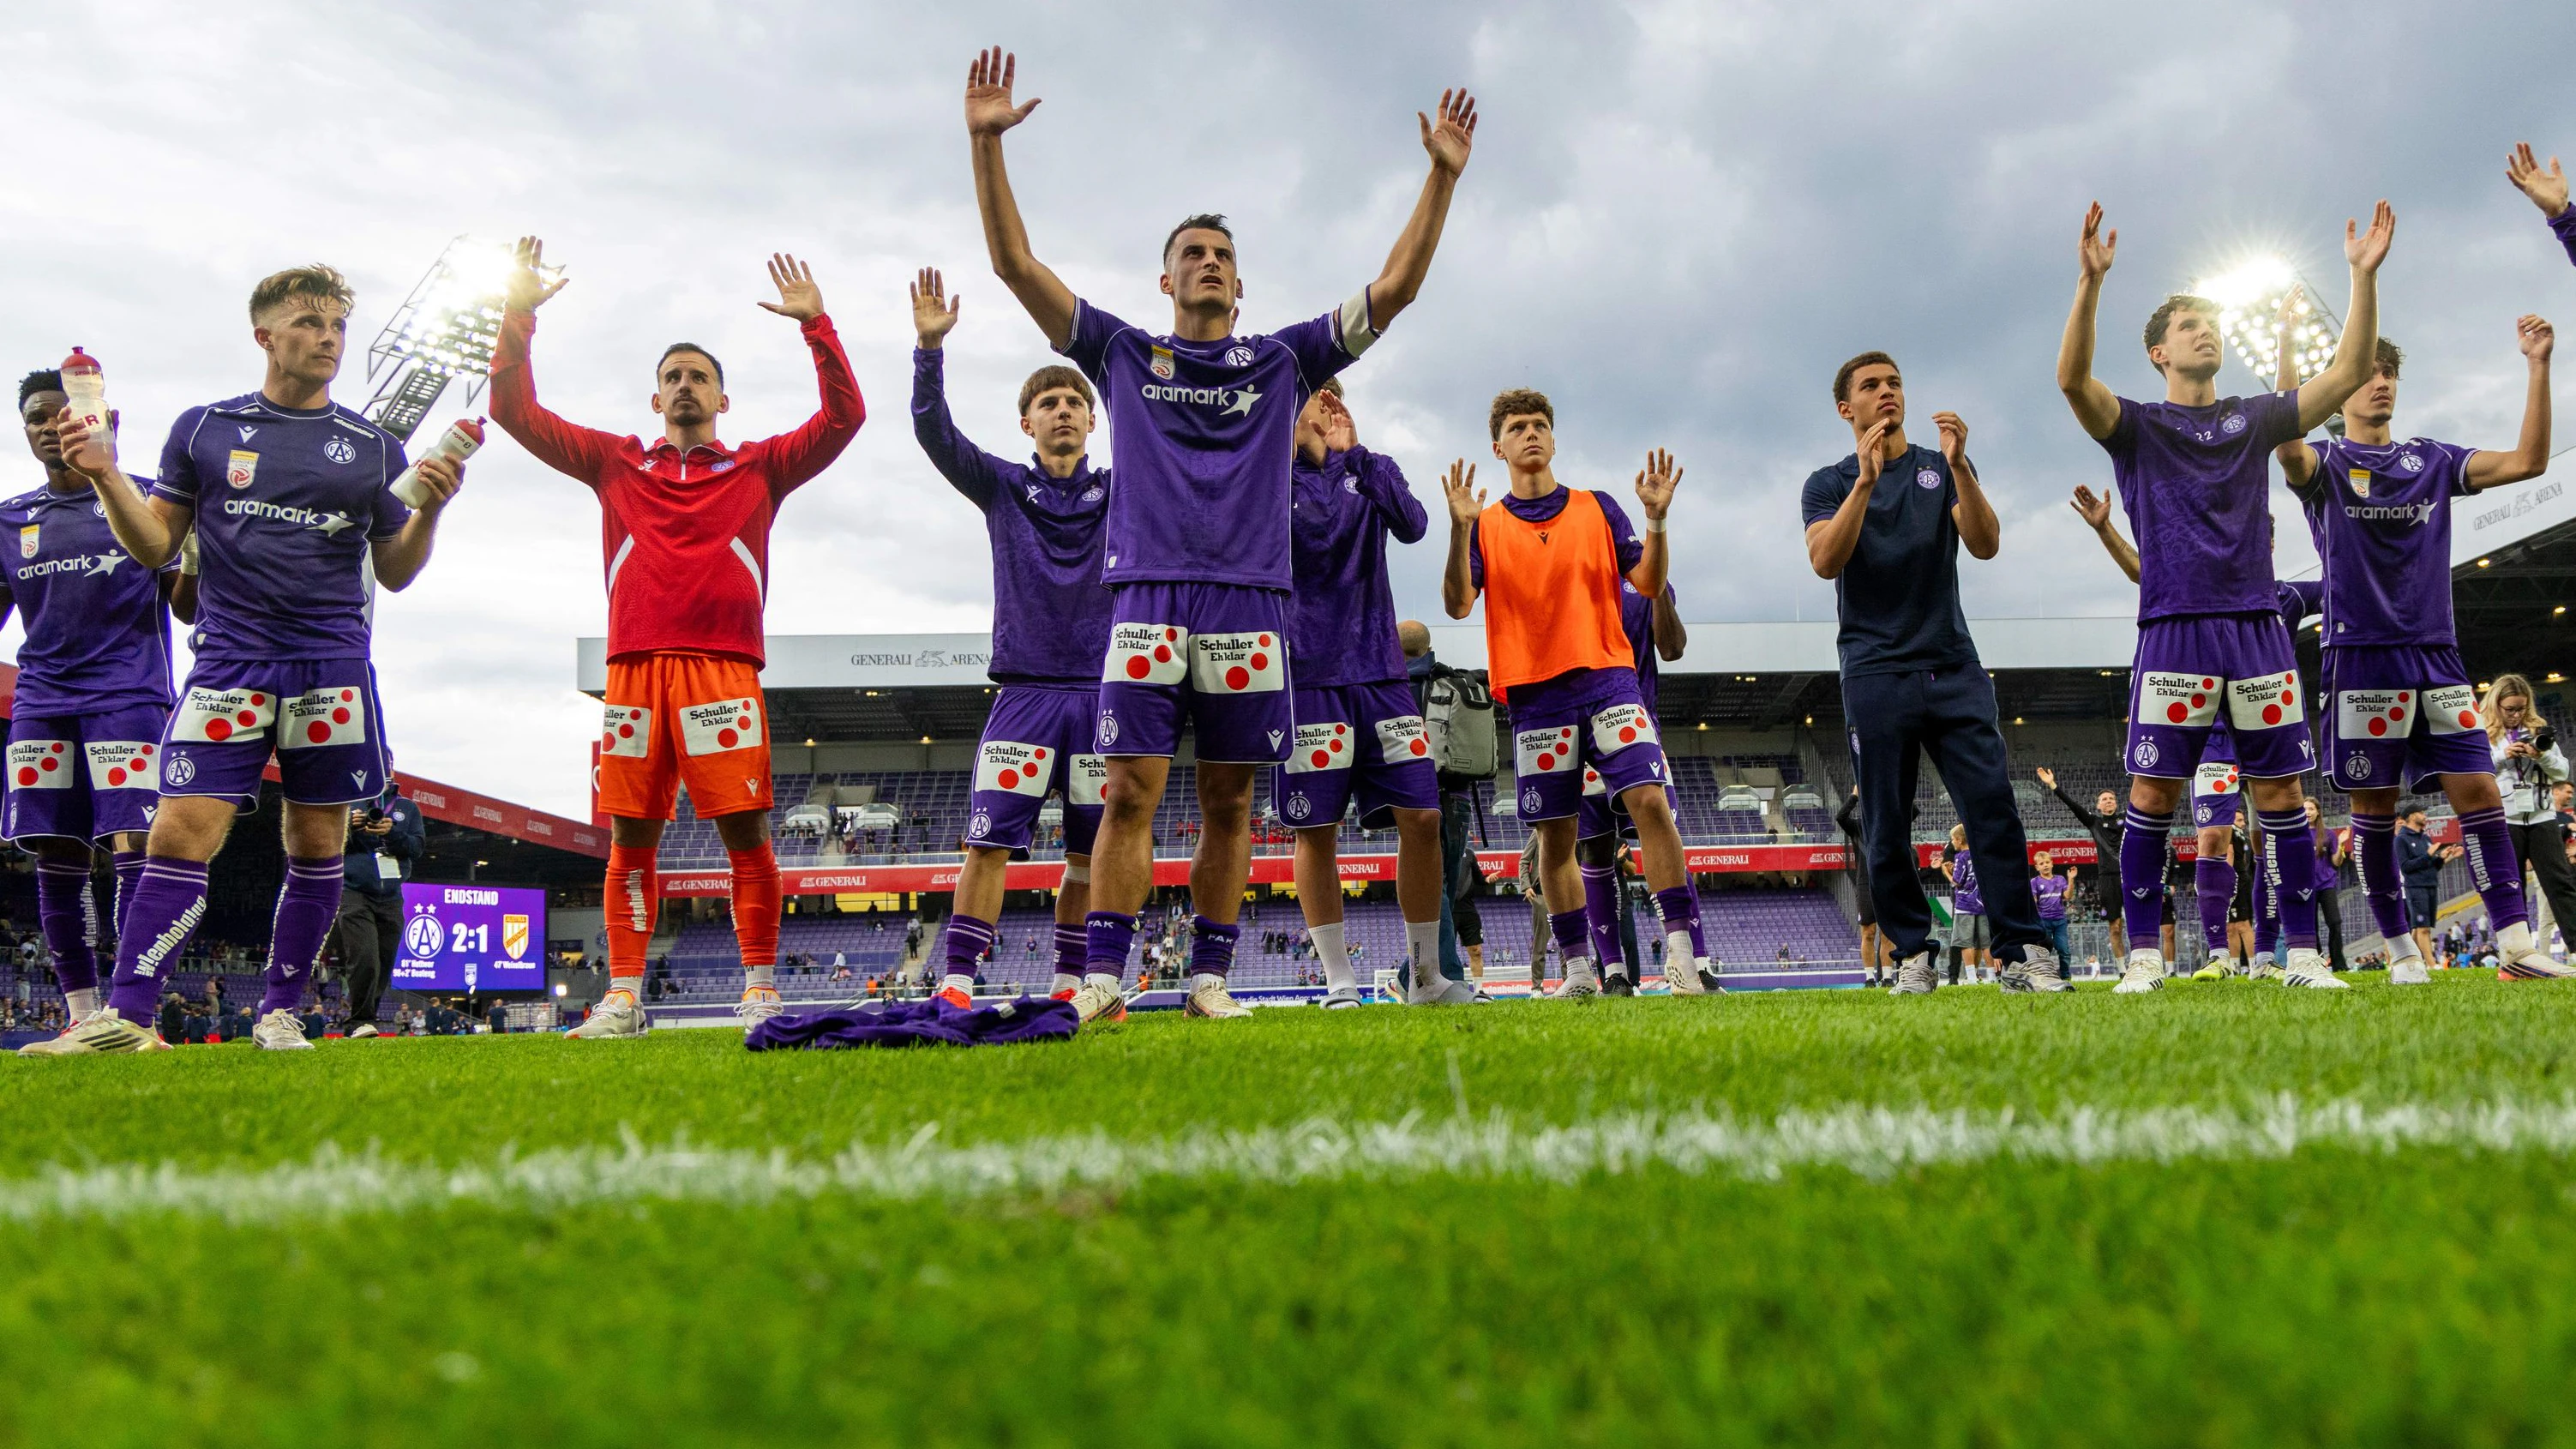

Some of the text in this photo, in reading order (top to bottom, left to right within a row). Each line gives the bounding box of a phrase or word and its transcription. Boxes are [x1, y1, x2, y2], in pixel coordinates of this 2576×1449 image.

[1142, 384, 1229, 406] aramark
[2195, 430, 2213, 442] 22
[224, 500, 319, 524] aramark
[2345, 502, 2415, 519] aramark
[2473, 482, 2563, 531] GENERALI ARENA
[17, 555, 92, 580] aramark
[1200, 639, 1253, 651] Schuller
[851, 653, 992, 665] GENERALI ARENA
[2148, 676, 2198, 688] Schuller
[2236, 680, 2282, 694] Schuller
[2347, 694, 2393, 703] Schuller
[2430, 690, 2471, 702] Schuller
[690, 706, 739, 719] Schuller
[1598, 708, 1636, 724] Schuller
[1384, 720, 1422, 731] Schuller
[1520, 732, 1558, 744] Schuller
[90, 746, 136, 755] Schuller
[985, 746, 1030, 758] Schuller
[420, 791, 446, 809] GENERALI
[479, 807, 502, 823] GENERALI
[1703, 855, 1749, 864] GENERALI
[815, 876, 866, 887] GENERALI
[444, 888, 498, 905] ENDSTAND
[1088, 919, 1114, 929] FAK
[452, 923, 488, 953] 2:1
[1208, 934, 1234, 944] FAK
